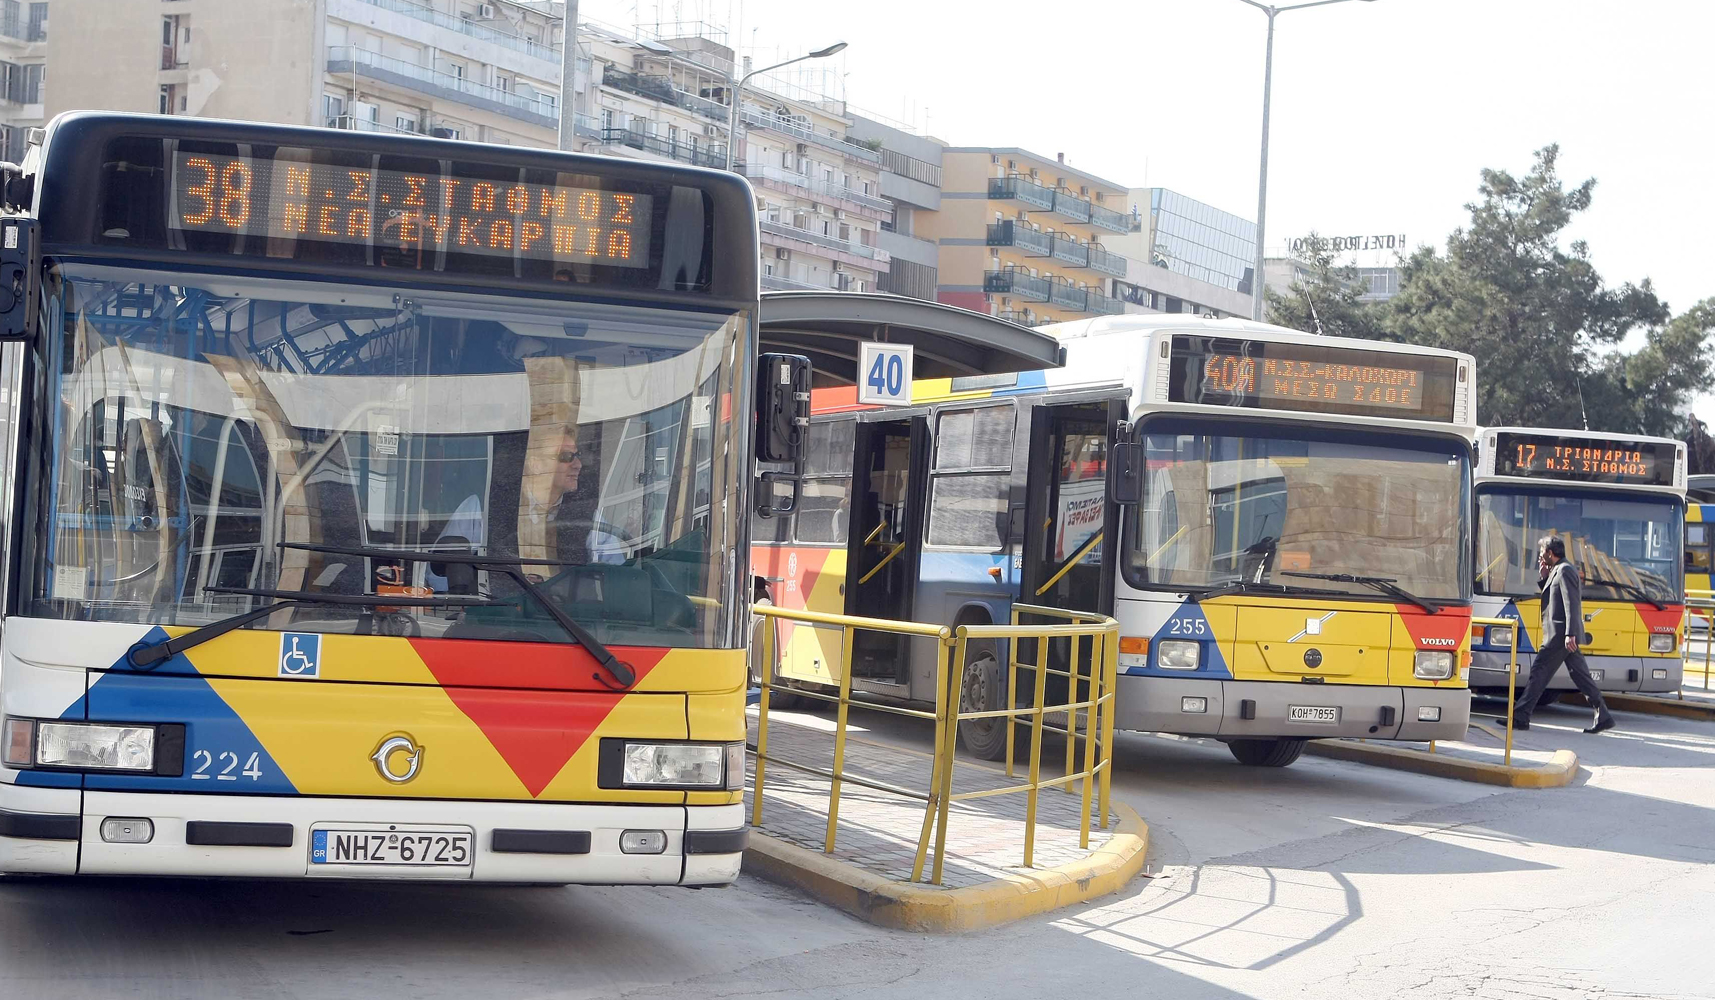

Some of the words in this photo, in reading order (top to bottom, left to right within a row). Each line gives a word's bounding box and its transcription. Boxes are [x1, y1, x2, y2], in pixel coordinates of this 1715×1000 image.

[183, 157, 252, 228] 38
[283, 202, 371, 238] ΝΕΑ
[400, 212, 631, 259] ΕΥΚΑΡΠΙΑ
[868, 353, 903, 396] 40
[1274, 379, 1338, 399] ΜΕΣΩ
[1353, 384, 1411, 404] ΣΔΟΕ
[1516, 444, 1536, 468] 17
[1554, 446, 1641, 463] ΤΡΙΑΝΔΡΙΑ
[1582, 461, 1646, 475] ΣΤΑΘΜΟΣ
[786, 579, 796, 592] 255
[1170, 618, 1205, 635] 255
[1420, 637, 1456, 646] VOLVO
[191, 750, 263, 781] 224
[313, 849, 326, 858] GR
[335, 835, 468, 862] NHZ-6725
